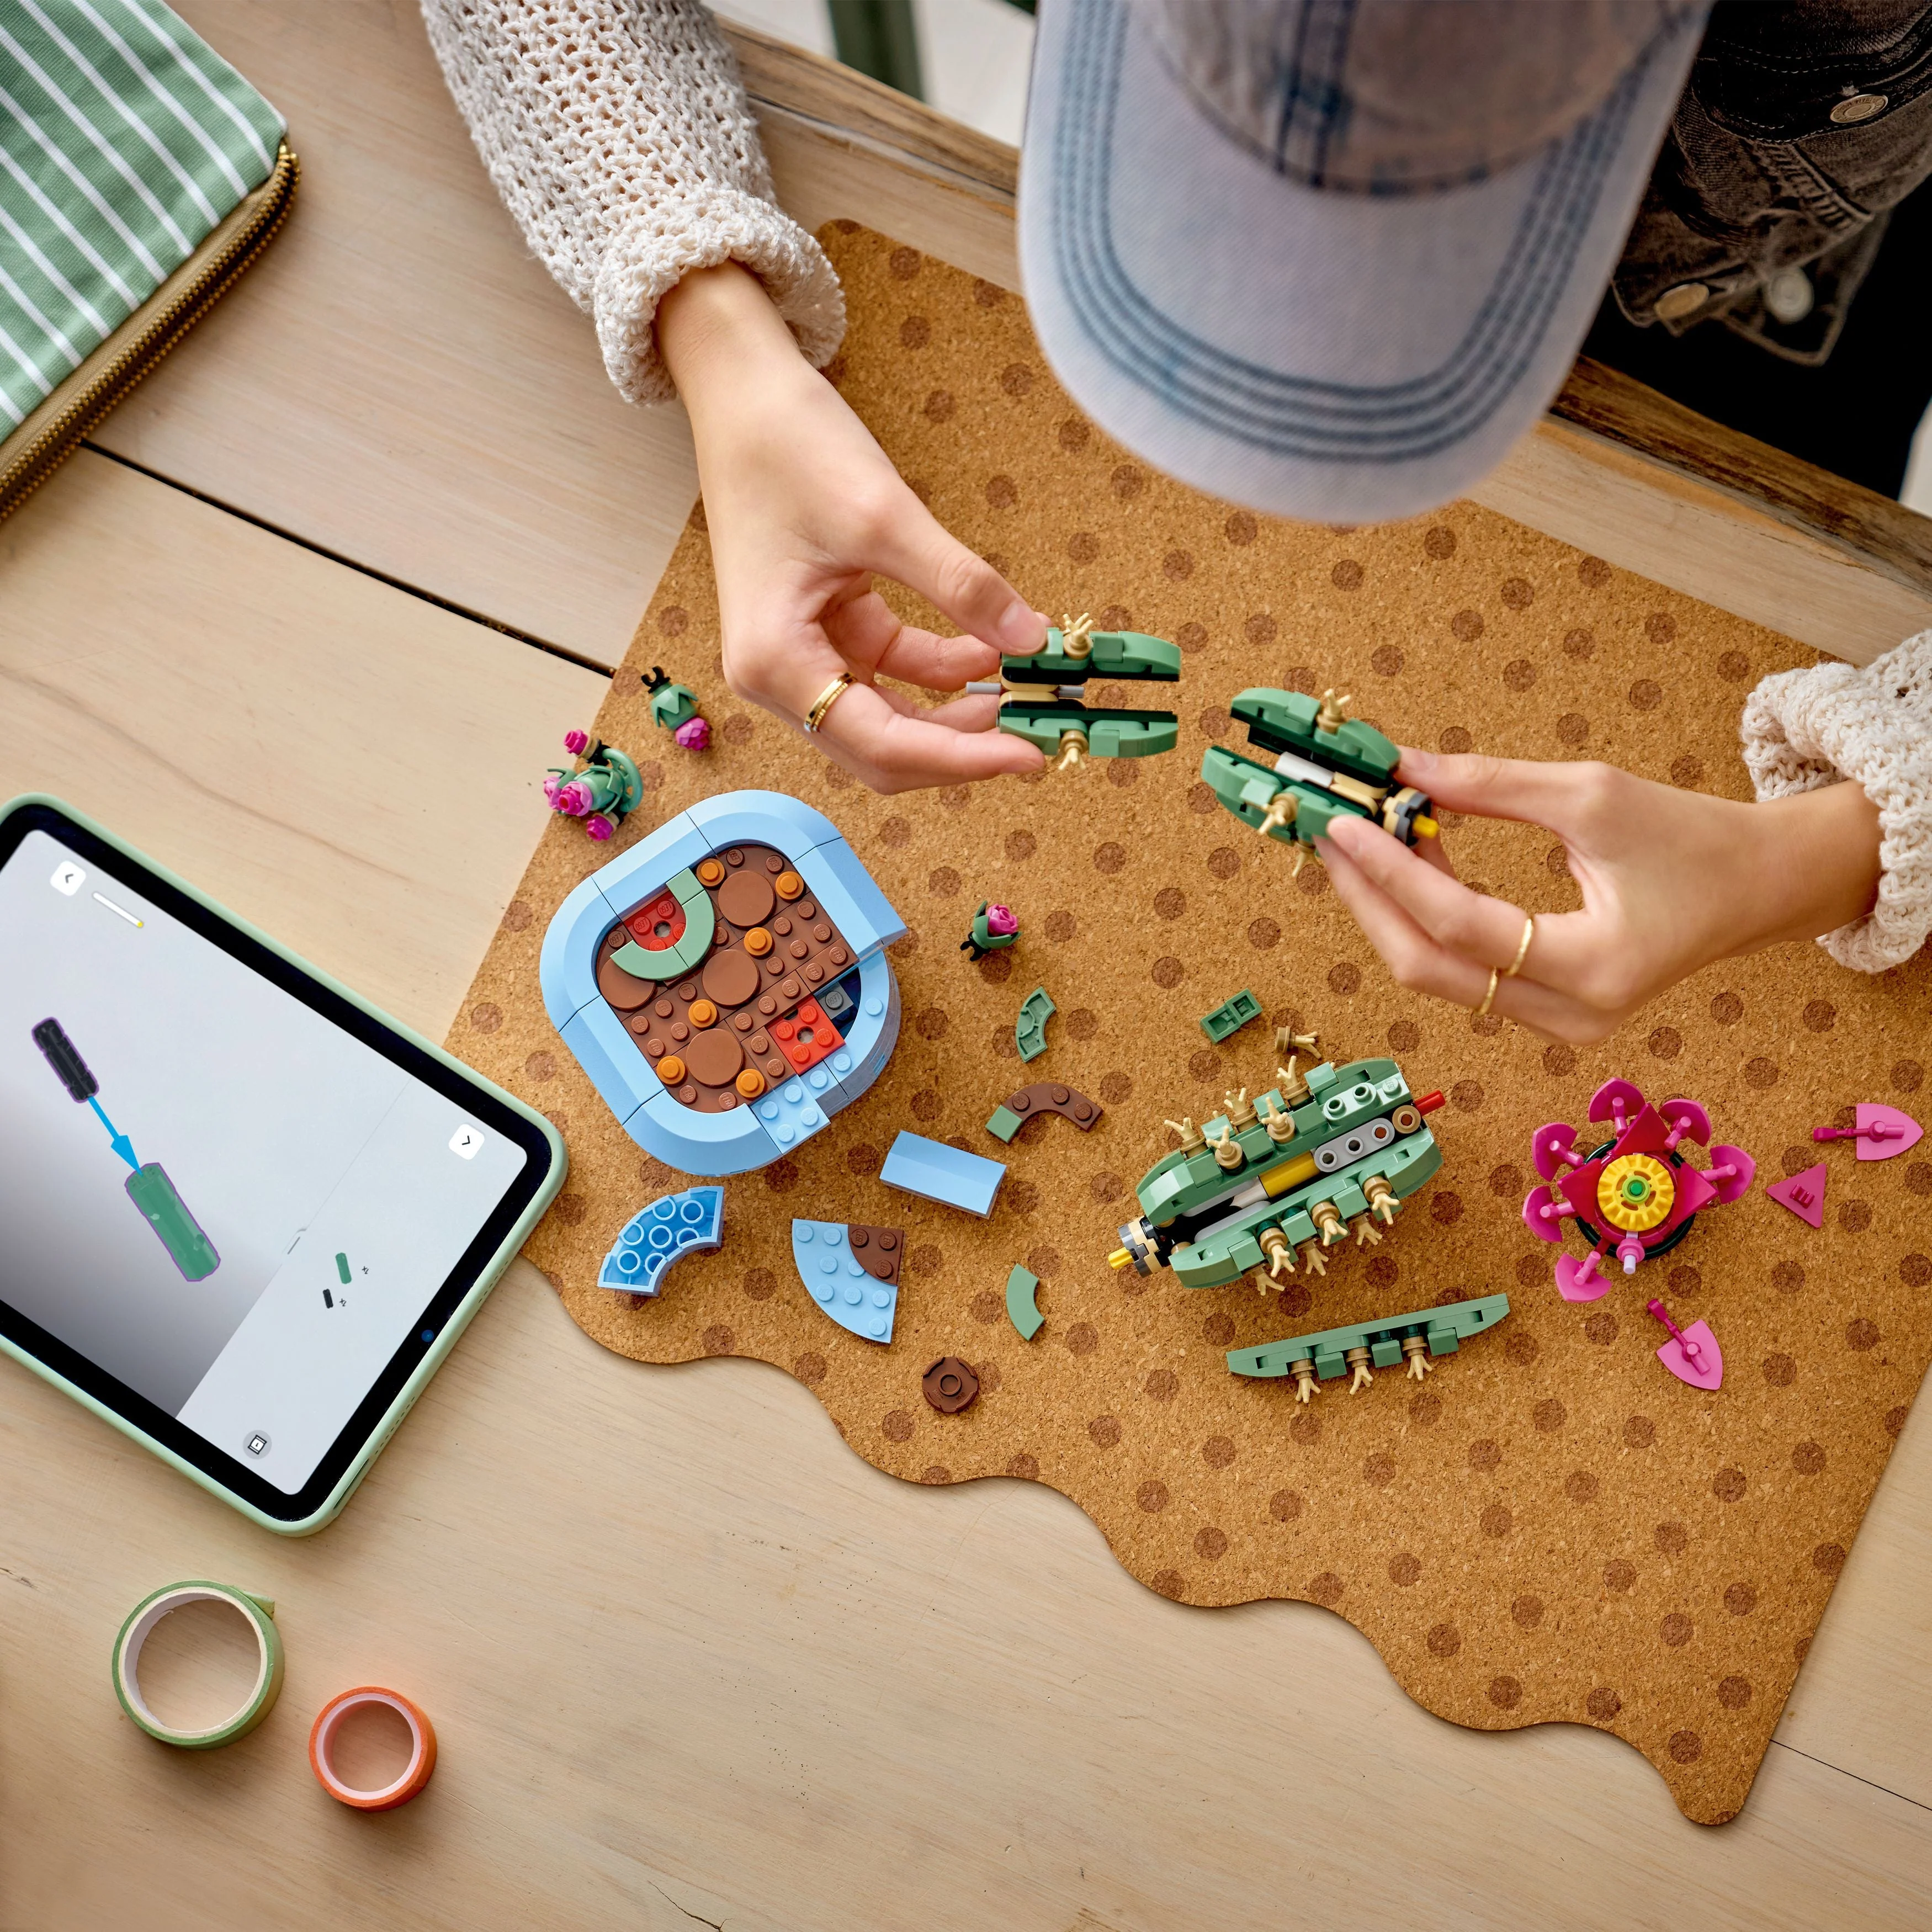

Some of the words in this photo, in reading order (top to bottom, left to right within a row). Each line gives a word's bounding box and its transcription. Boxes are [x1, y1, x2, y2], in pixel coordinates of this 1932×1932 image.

[660, 902, 671, 914] LEGO
[635, 918, 647, 930] LEGO
[610, 933, 622, 945] LEGO
[832, 948, 843, 961] LEGO
[828, 994, 840, 1005] LEGO
[362, 1266, 369, 1274] 1x
[339, 1298, 347, 1307] 1x
